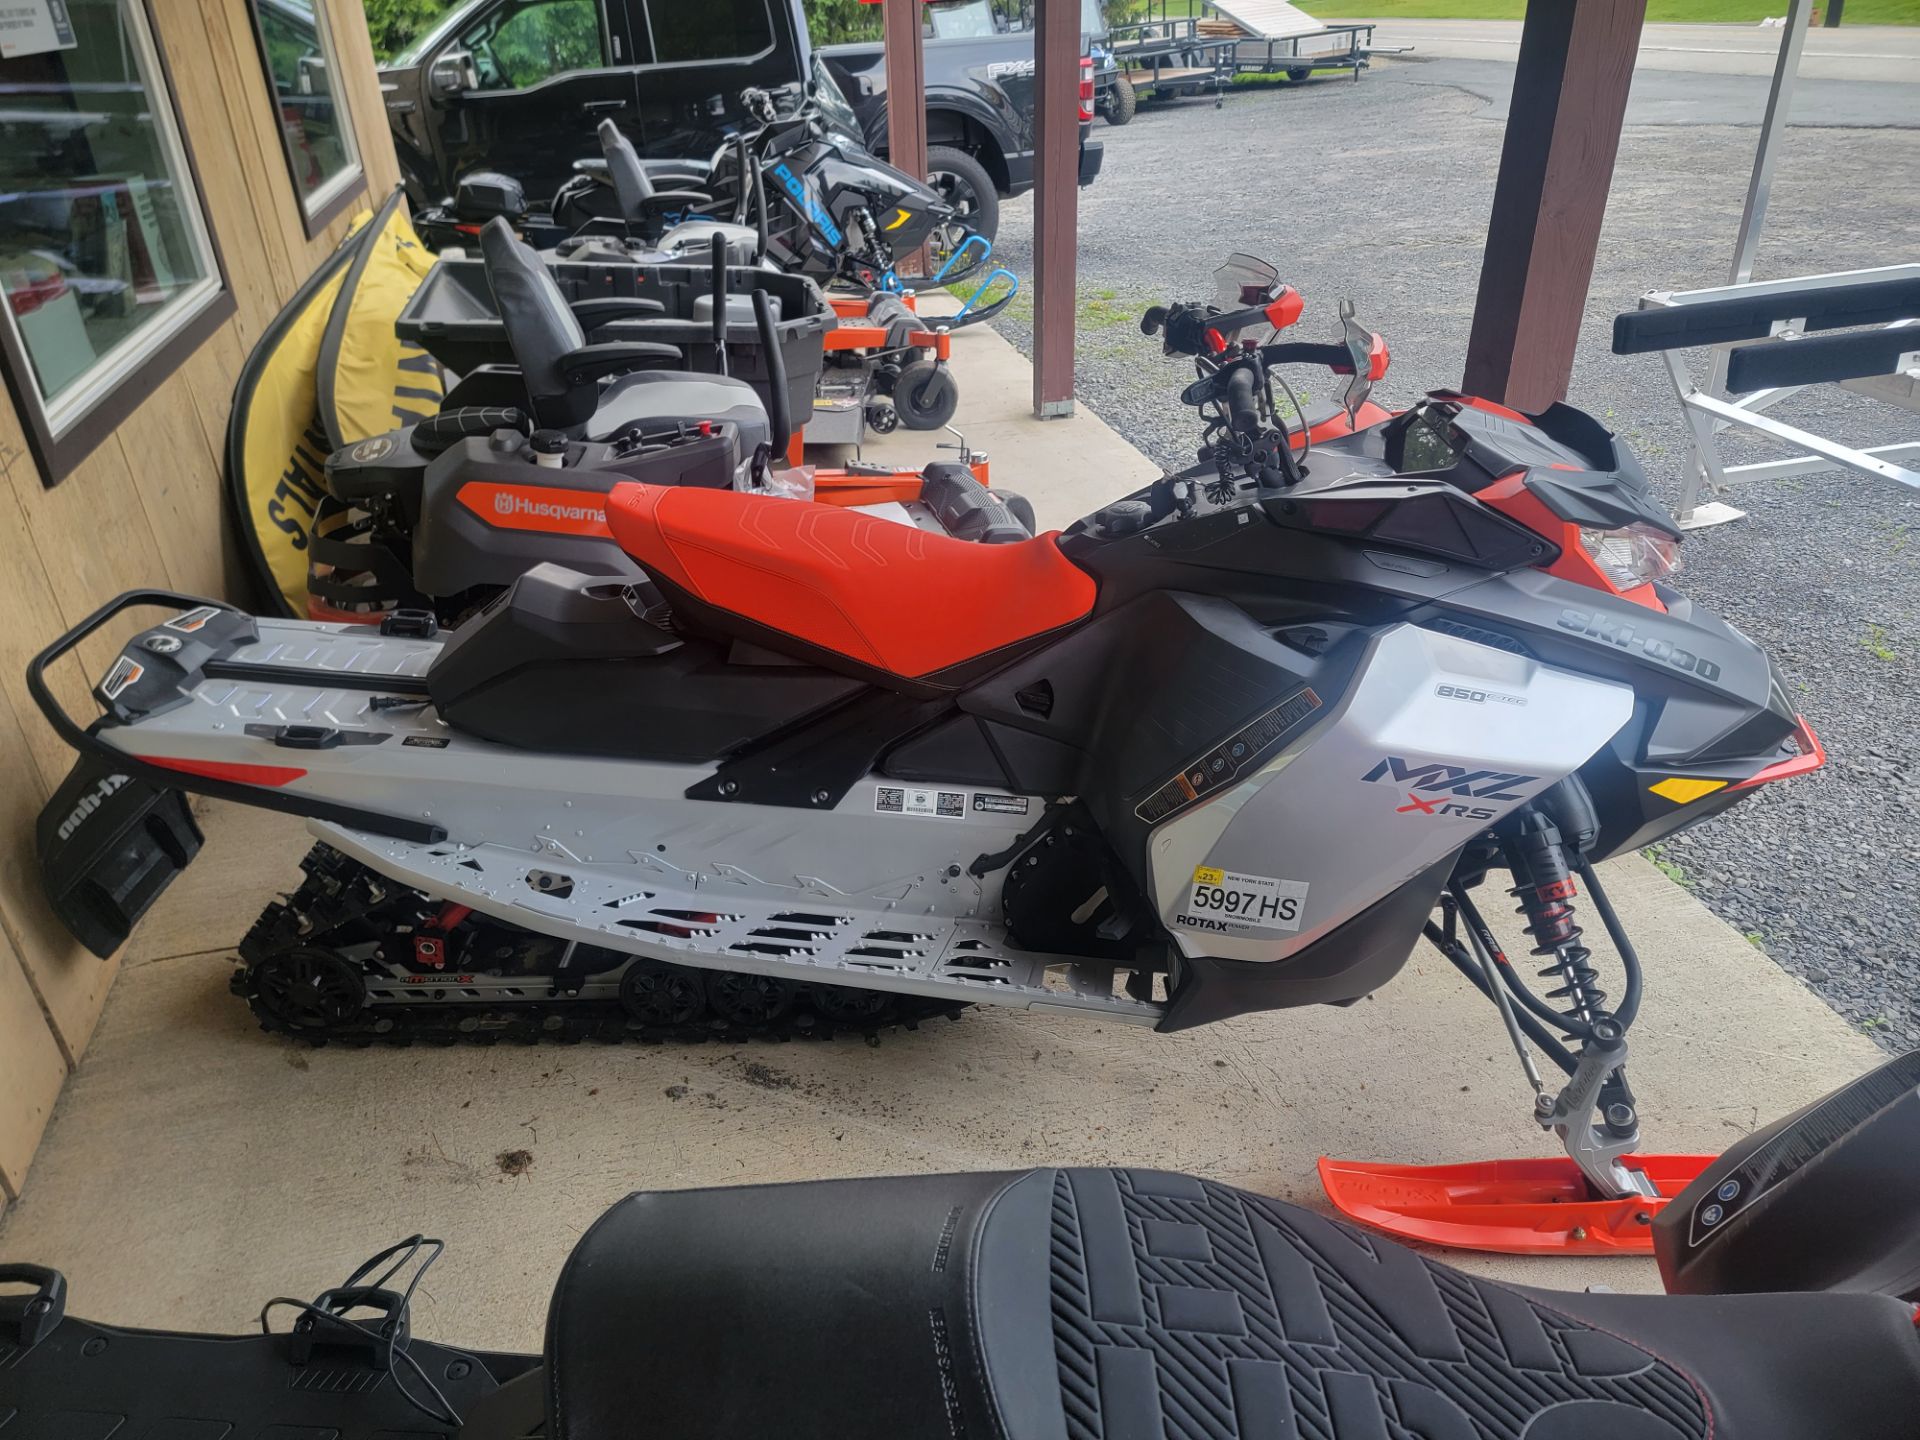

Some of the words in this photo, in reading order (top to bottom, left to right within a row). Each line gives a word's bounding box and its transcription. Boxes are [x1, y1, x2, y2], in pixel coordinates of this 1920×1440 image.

[514, 498, 607, 523] Husqvarna
[1437, 685, 1487, 702] 850
[1360, 756, 1541, 802] MXZ
[1176, 914, 1229, 932] ROTAX
